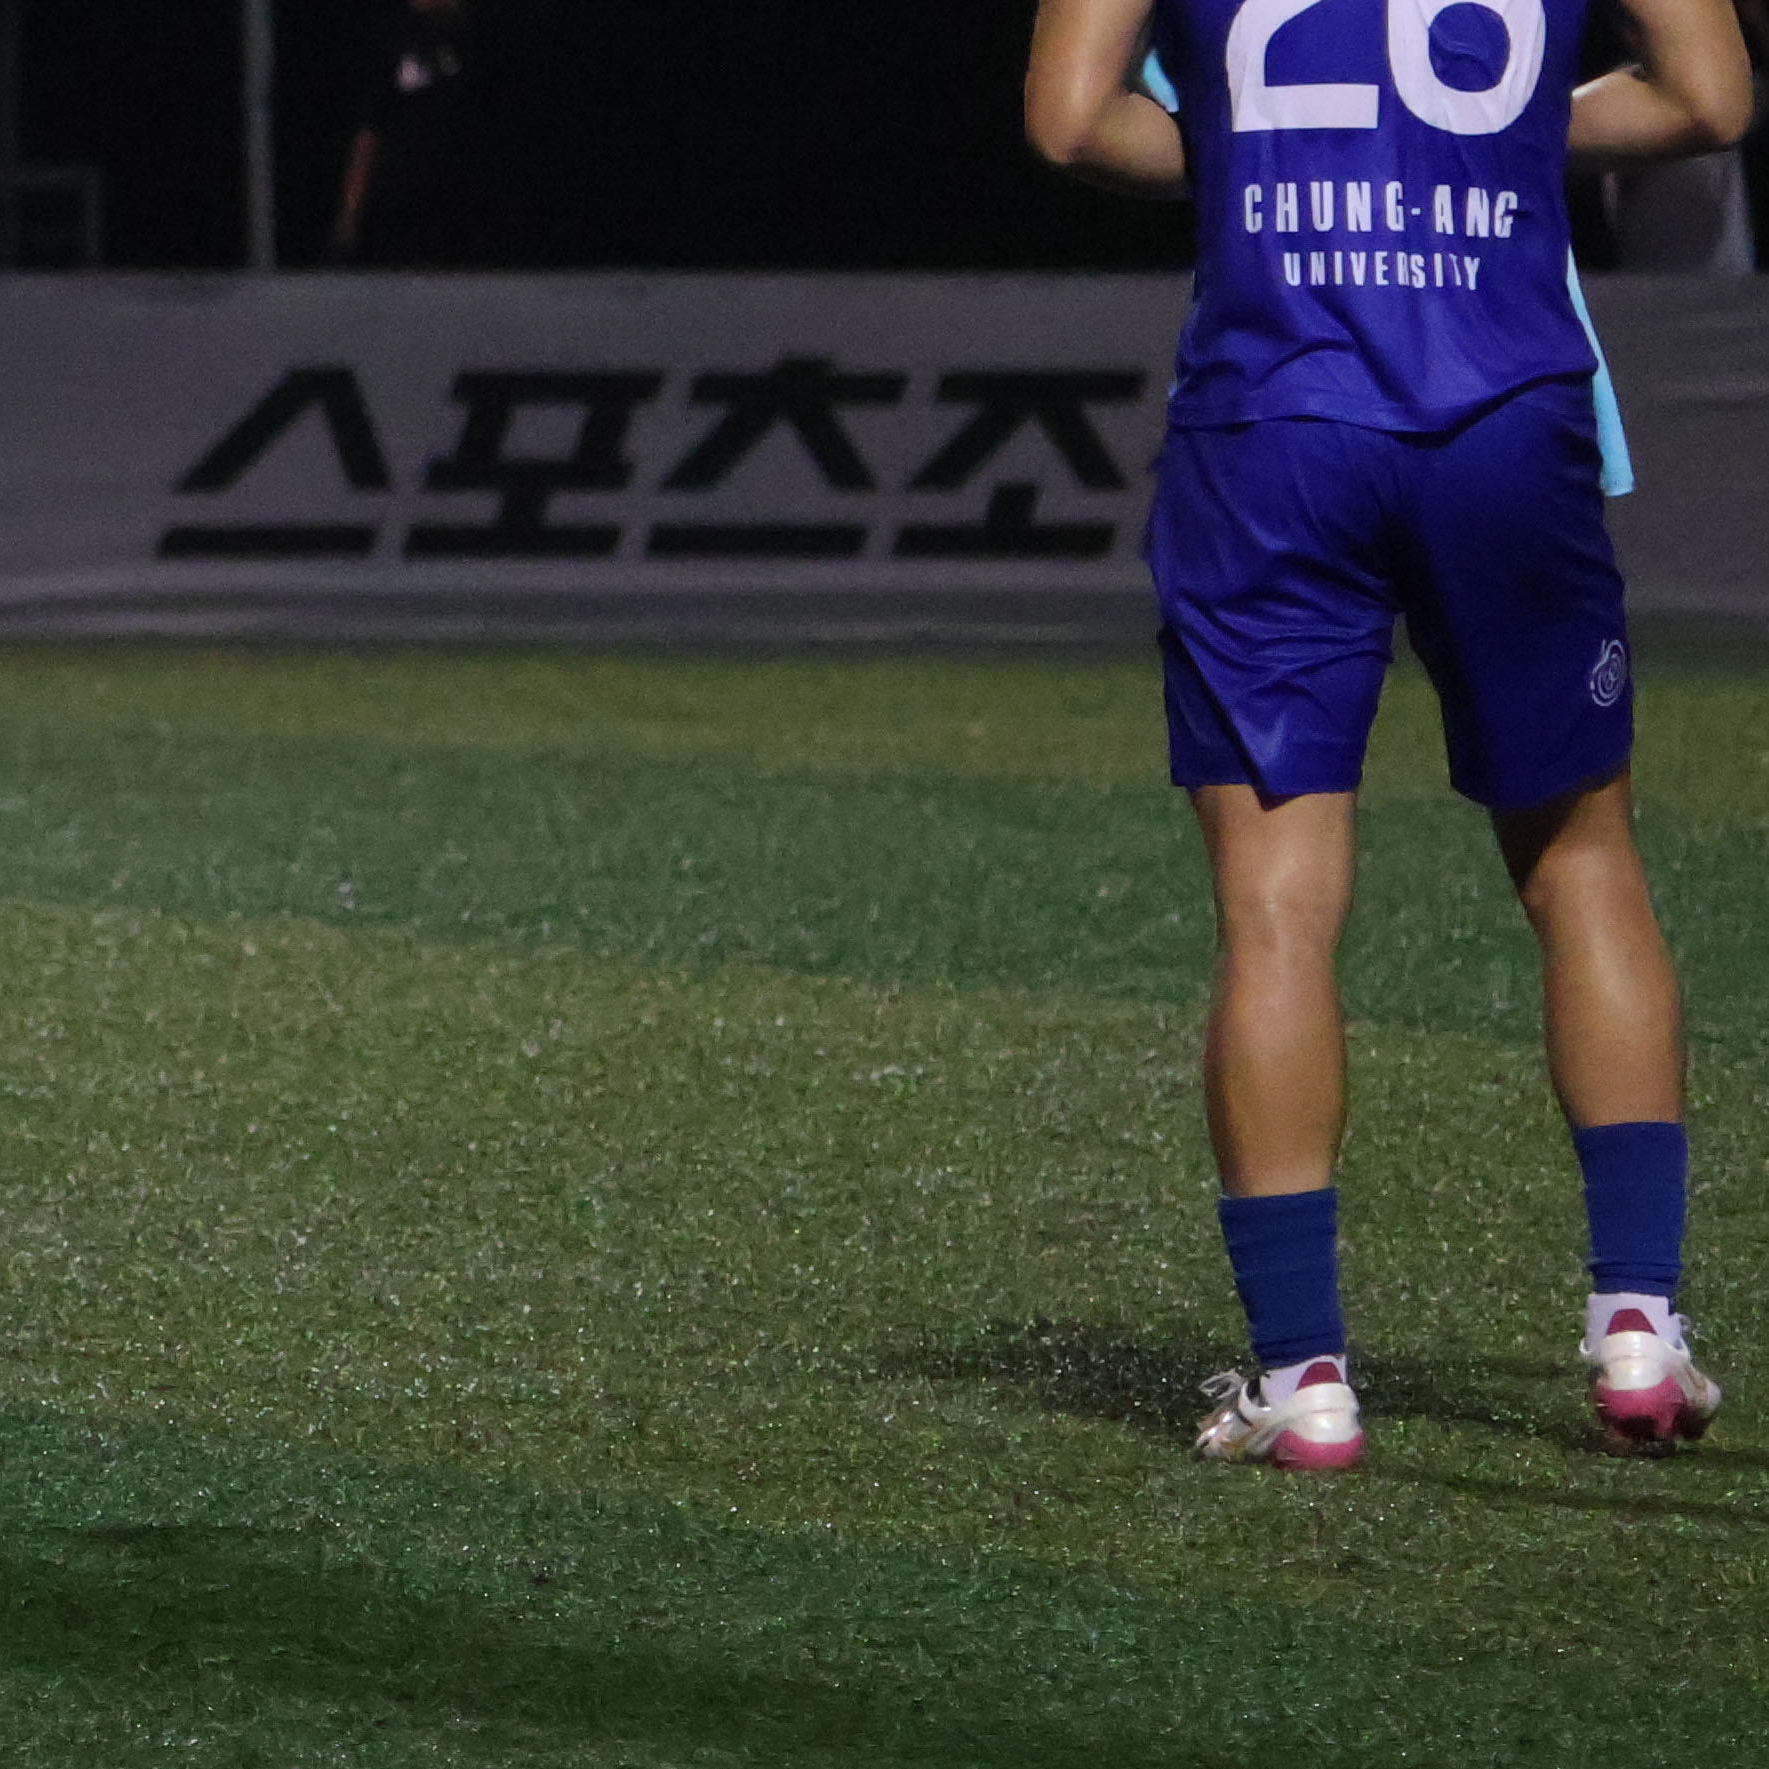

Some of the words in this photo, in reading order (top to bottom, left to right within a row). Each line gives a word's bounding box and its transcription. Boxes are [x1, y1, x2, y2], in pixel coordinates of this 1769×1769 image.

[1243, 180, 1520, 238] CHUNG-ANG
[1282, 250, 1481, 291] UNIVERSITY
[157, 353, 1149, 559] 스포츠조
